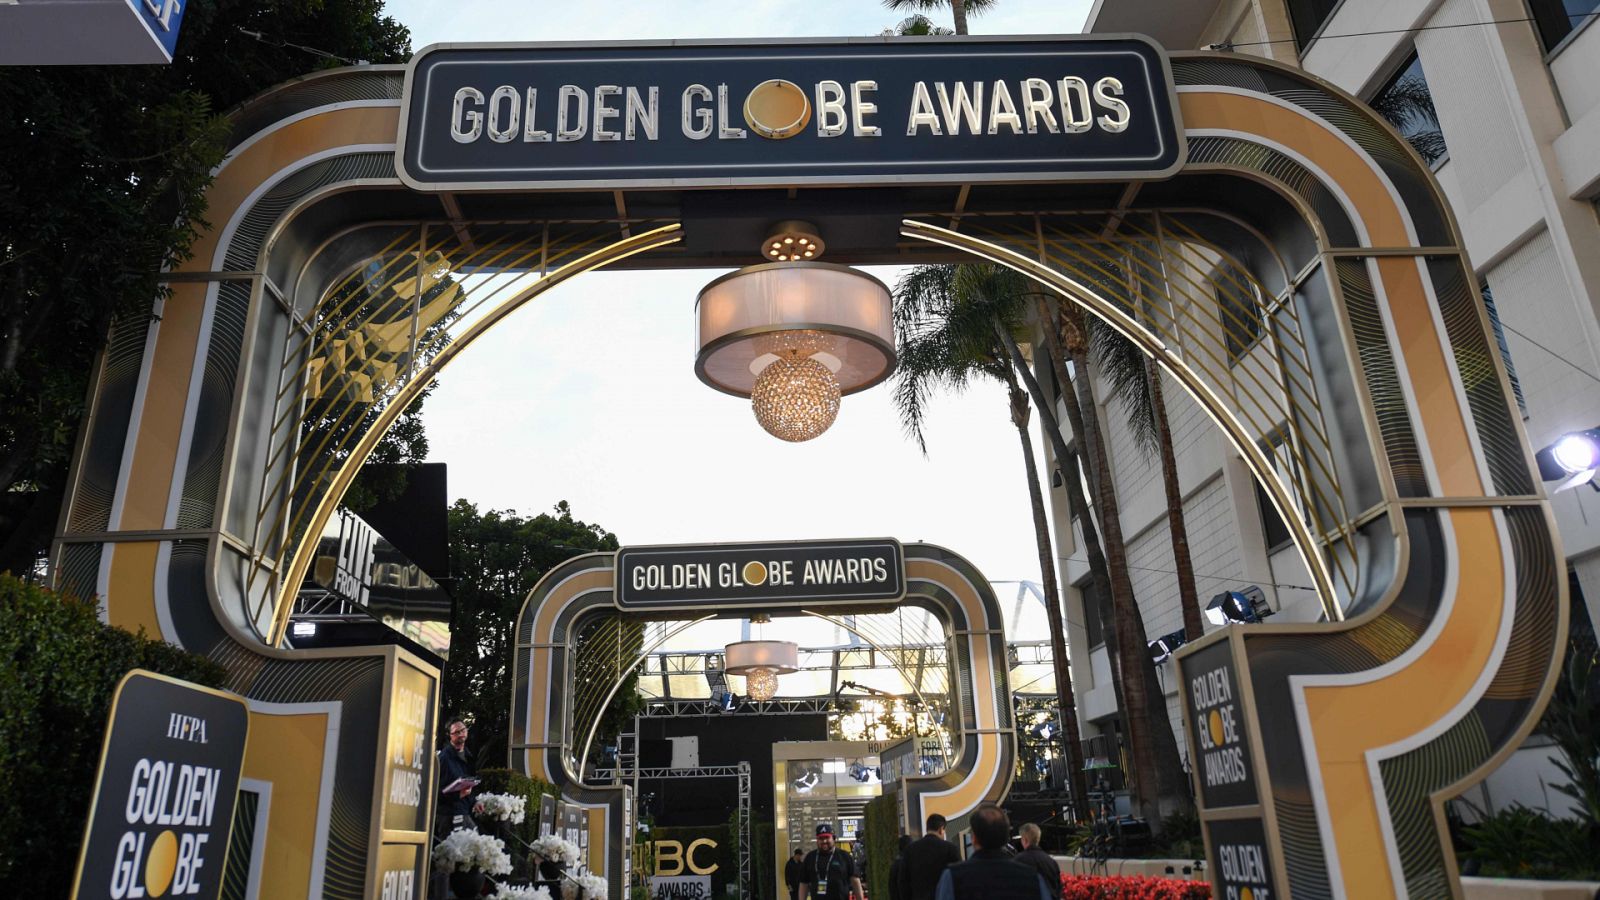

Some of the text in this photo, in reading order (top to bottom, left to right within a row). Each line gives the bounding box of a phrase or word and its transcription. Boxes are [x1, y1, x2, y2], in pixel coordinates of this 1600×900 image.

[450, 76, 1131, 144] GOLDEN GLOBE AWARDS
[337, 513, 380, 587] LIVE
[335, 567, 361, 603] FROM
[632, 557, 888, 591] GOLDEN GLOBE AWARDS
[397, 686, 428, 730] GOLDEN
[1193, 667, 1231, 710] GOLDEN
[166, 712, 209, 744] HFPA
[1199, 704, 1239, 749] GLOBE
[1205, 748, 1246, 786] AWARDS
[125, 758, 221, 827] GOLDEN
[389, 768, 422, 808] AWARDS
[110, 829, 209, 900] GLOBE
[1219, 845, 1267, 884] GOLDEN
[658, 882, 704, 898] AWARDS
